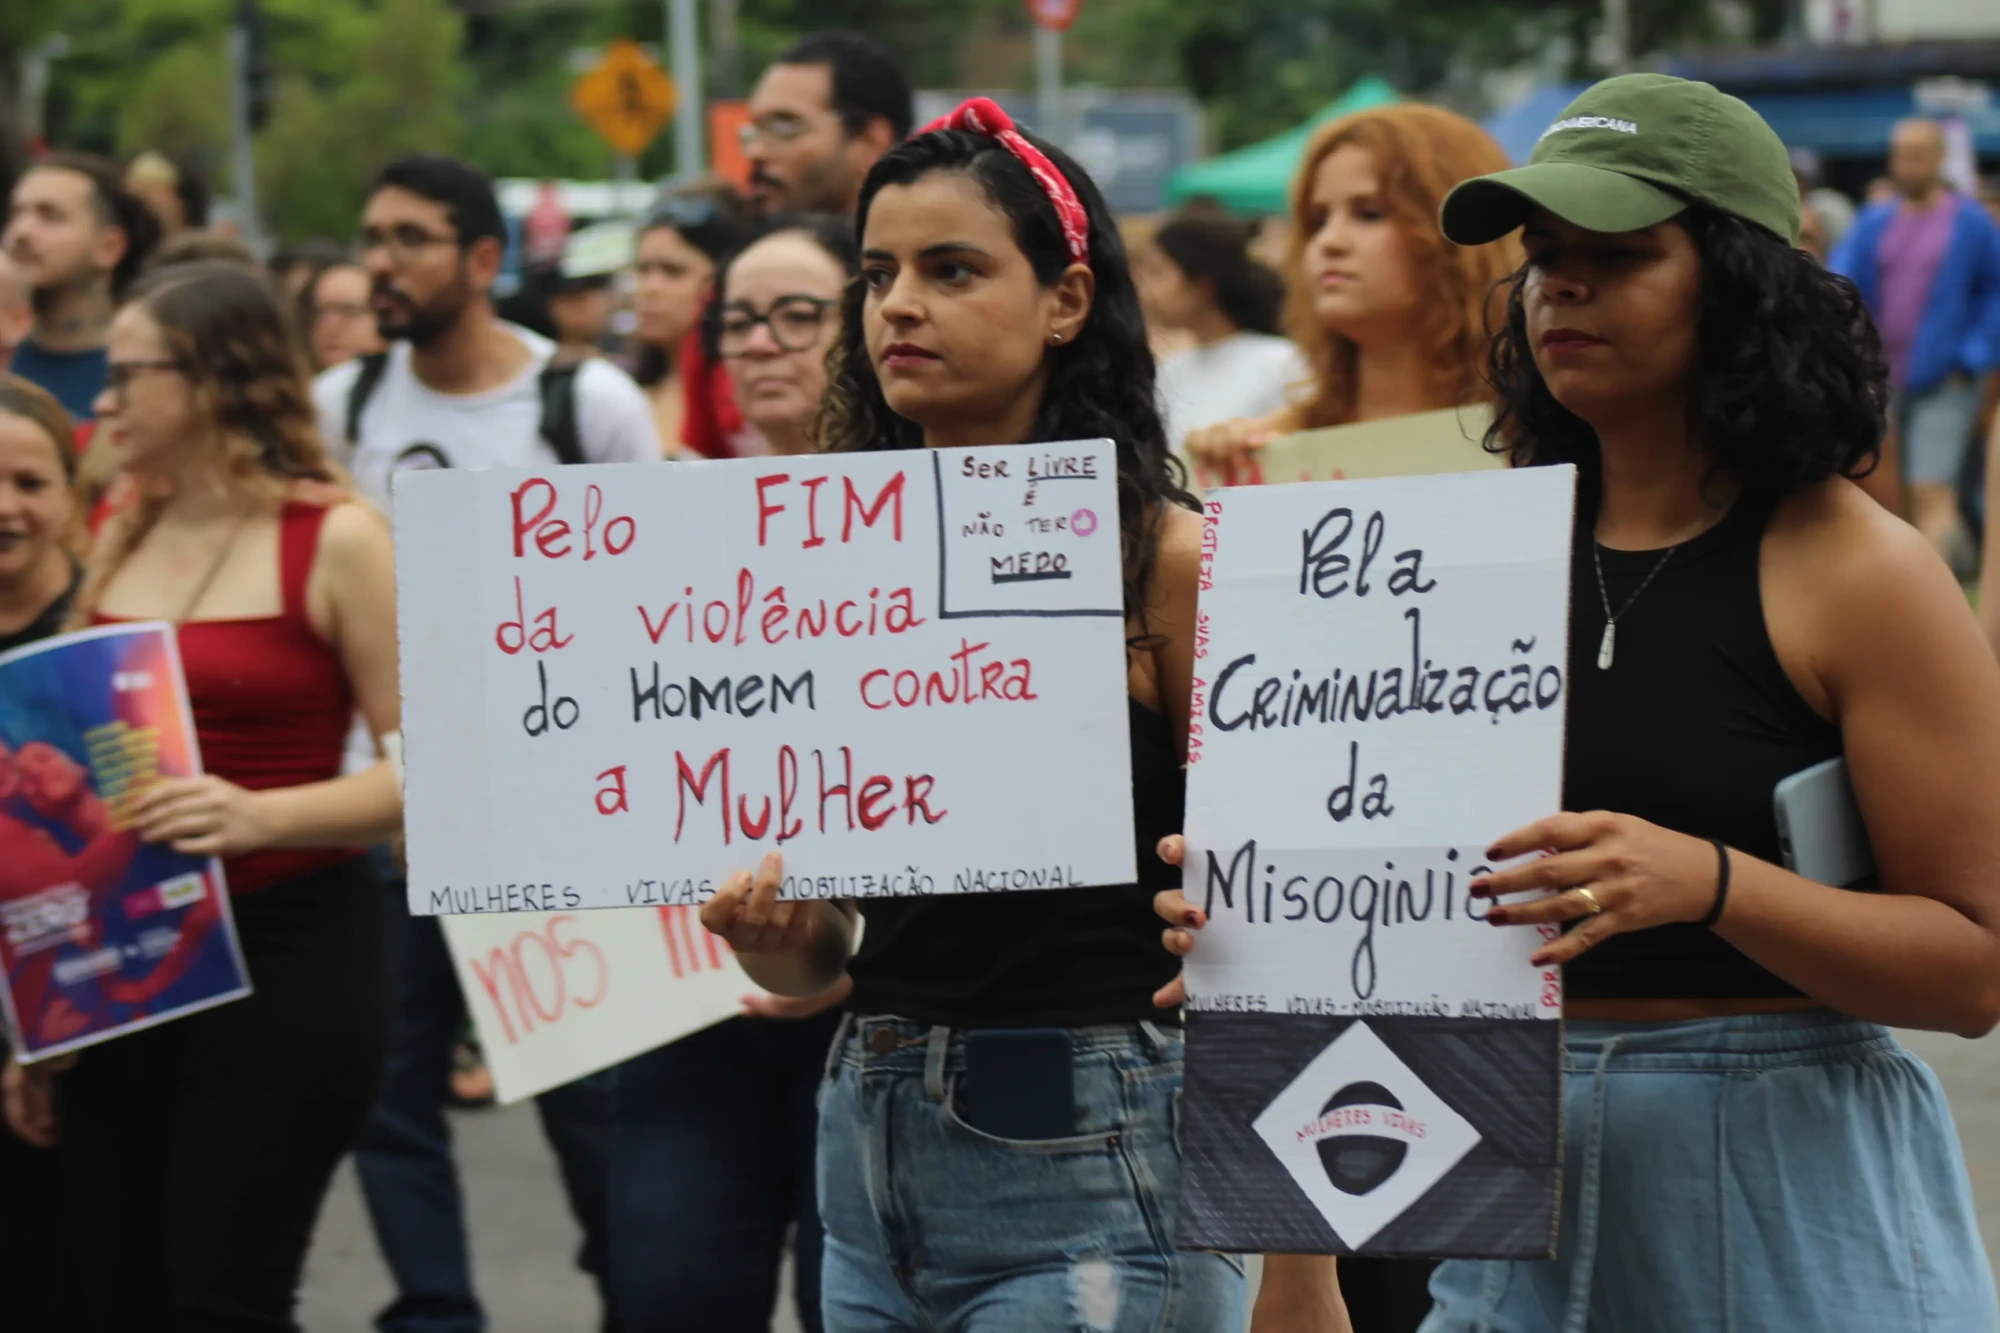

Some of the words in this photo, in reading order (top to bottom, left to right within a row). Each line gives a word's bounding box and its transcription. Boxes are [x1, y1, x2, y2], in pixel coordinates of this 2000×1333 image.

[510, 477, 636, 561] Pelo
[755, 470, 906, 548] FIM
[962, 511, 1004, 537] NÃO
[1024, 516, 1067, 533] TER
[1199, 501, 1222, 591] PROTEJA
[1299, 507, 1438, 598] Pela
[991, 552, 1067, 573] MEDO
[496, 575, 575, 654] da
[1194, 609, 1210, 660] SUAS
[523, 660, 579, 737] do
[1187, 677, 1207, 764] AMIGAS
[594, 765, 629, 815] a
[1327, 741, 1394, 822] da
[430, 883, 581, 914] MULHERES
[626, 879, 716, 905] VIVAS
[953, 865, 1084, 893] NACIONAL
[1296, 1108, 1372, 1142] MULHERES
